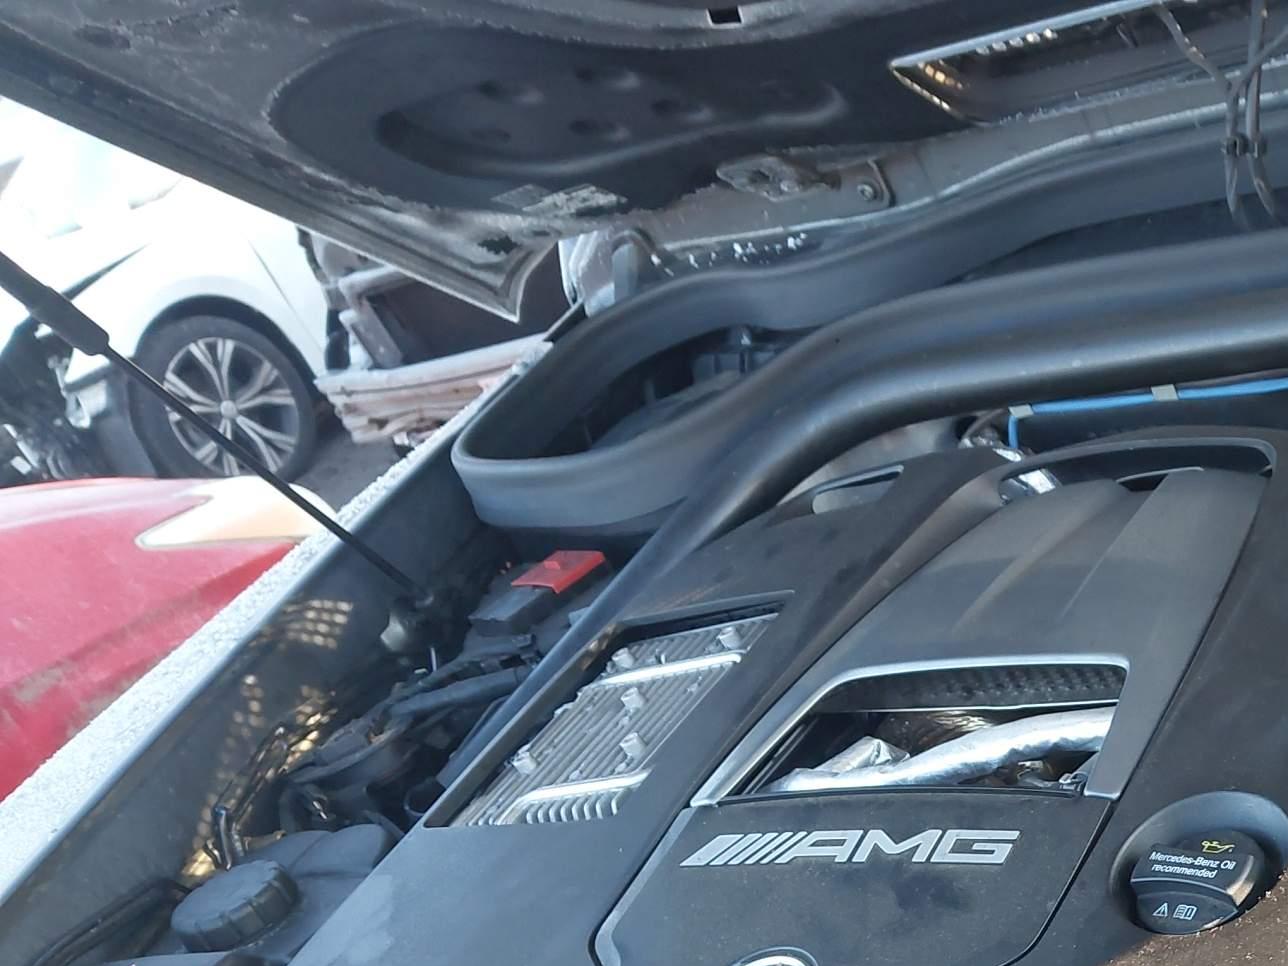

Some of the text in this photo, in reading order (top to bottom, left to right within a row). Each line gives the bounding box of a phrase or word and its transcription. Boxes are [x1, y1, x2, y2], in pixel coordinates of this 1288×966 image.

[778, 829, 1021, 864] AMG
[1149, 851, 1237, 871] Mercedes-Benz Oil
[1151, 864, 1218, 879] recommended
